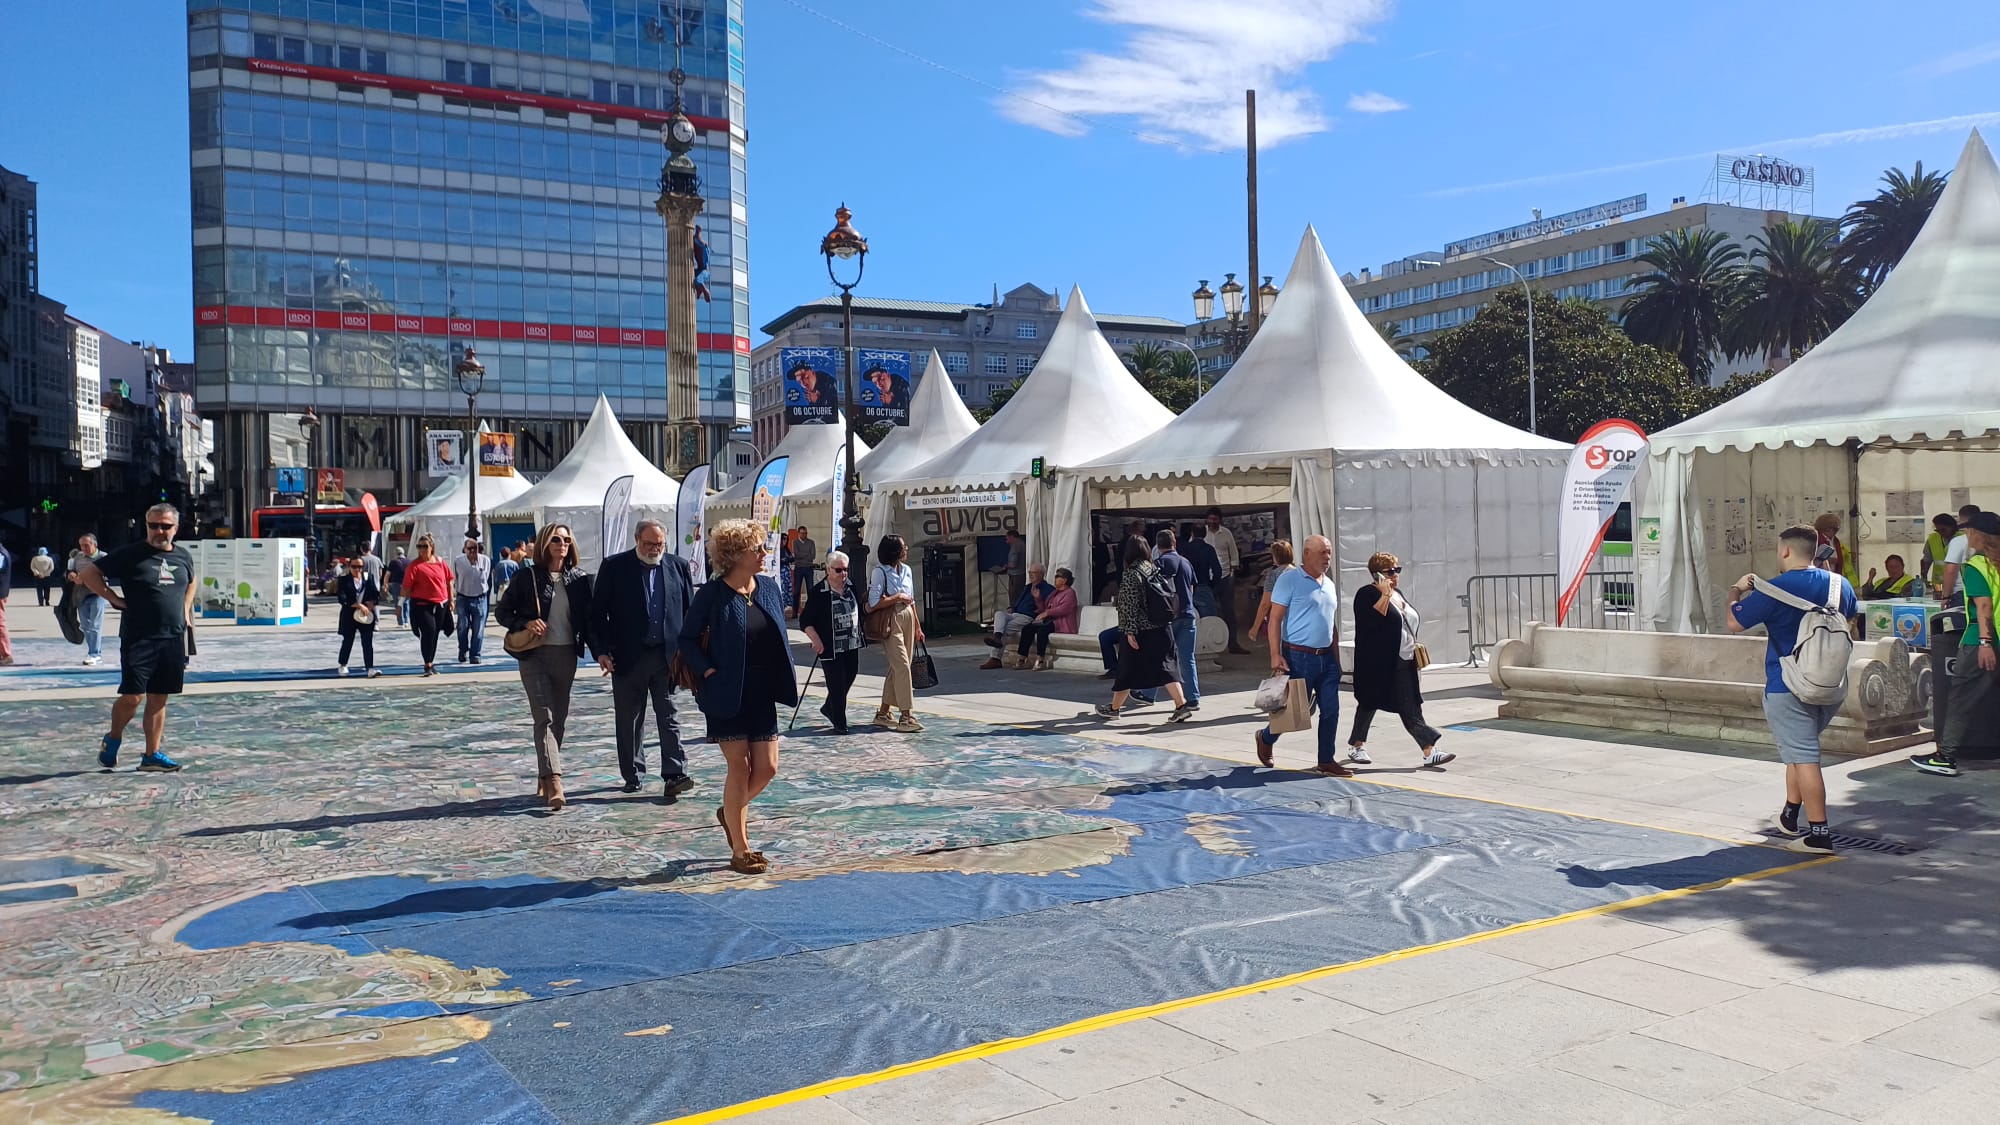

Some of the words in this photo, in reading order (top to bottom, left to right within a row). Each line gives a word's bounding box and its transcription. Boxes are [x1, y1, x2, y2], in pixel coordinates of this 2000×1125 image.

[1731, 159, 1804, 186] CASINO
[793, 406, 802, 415] 06
[803, 406, 832, 416] OCTUBRE
[865, 407, 875, 416] 06
[876, 407, 905, 417] OCTUBRE
[1589, 447, 1637, 466] STOP
[922, 497, 939, 505] CENTRO
[940, 496, 961, 504] INTEGRAL
[968, 494, 996, 503] MOBILIDADE
